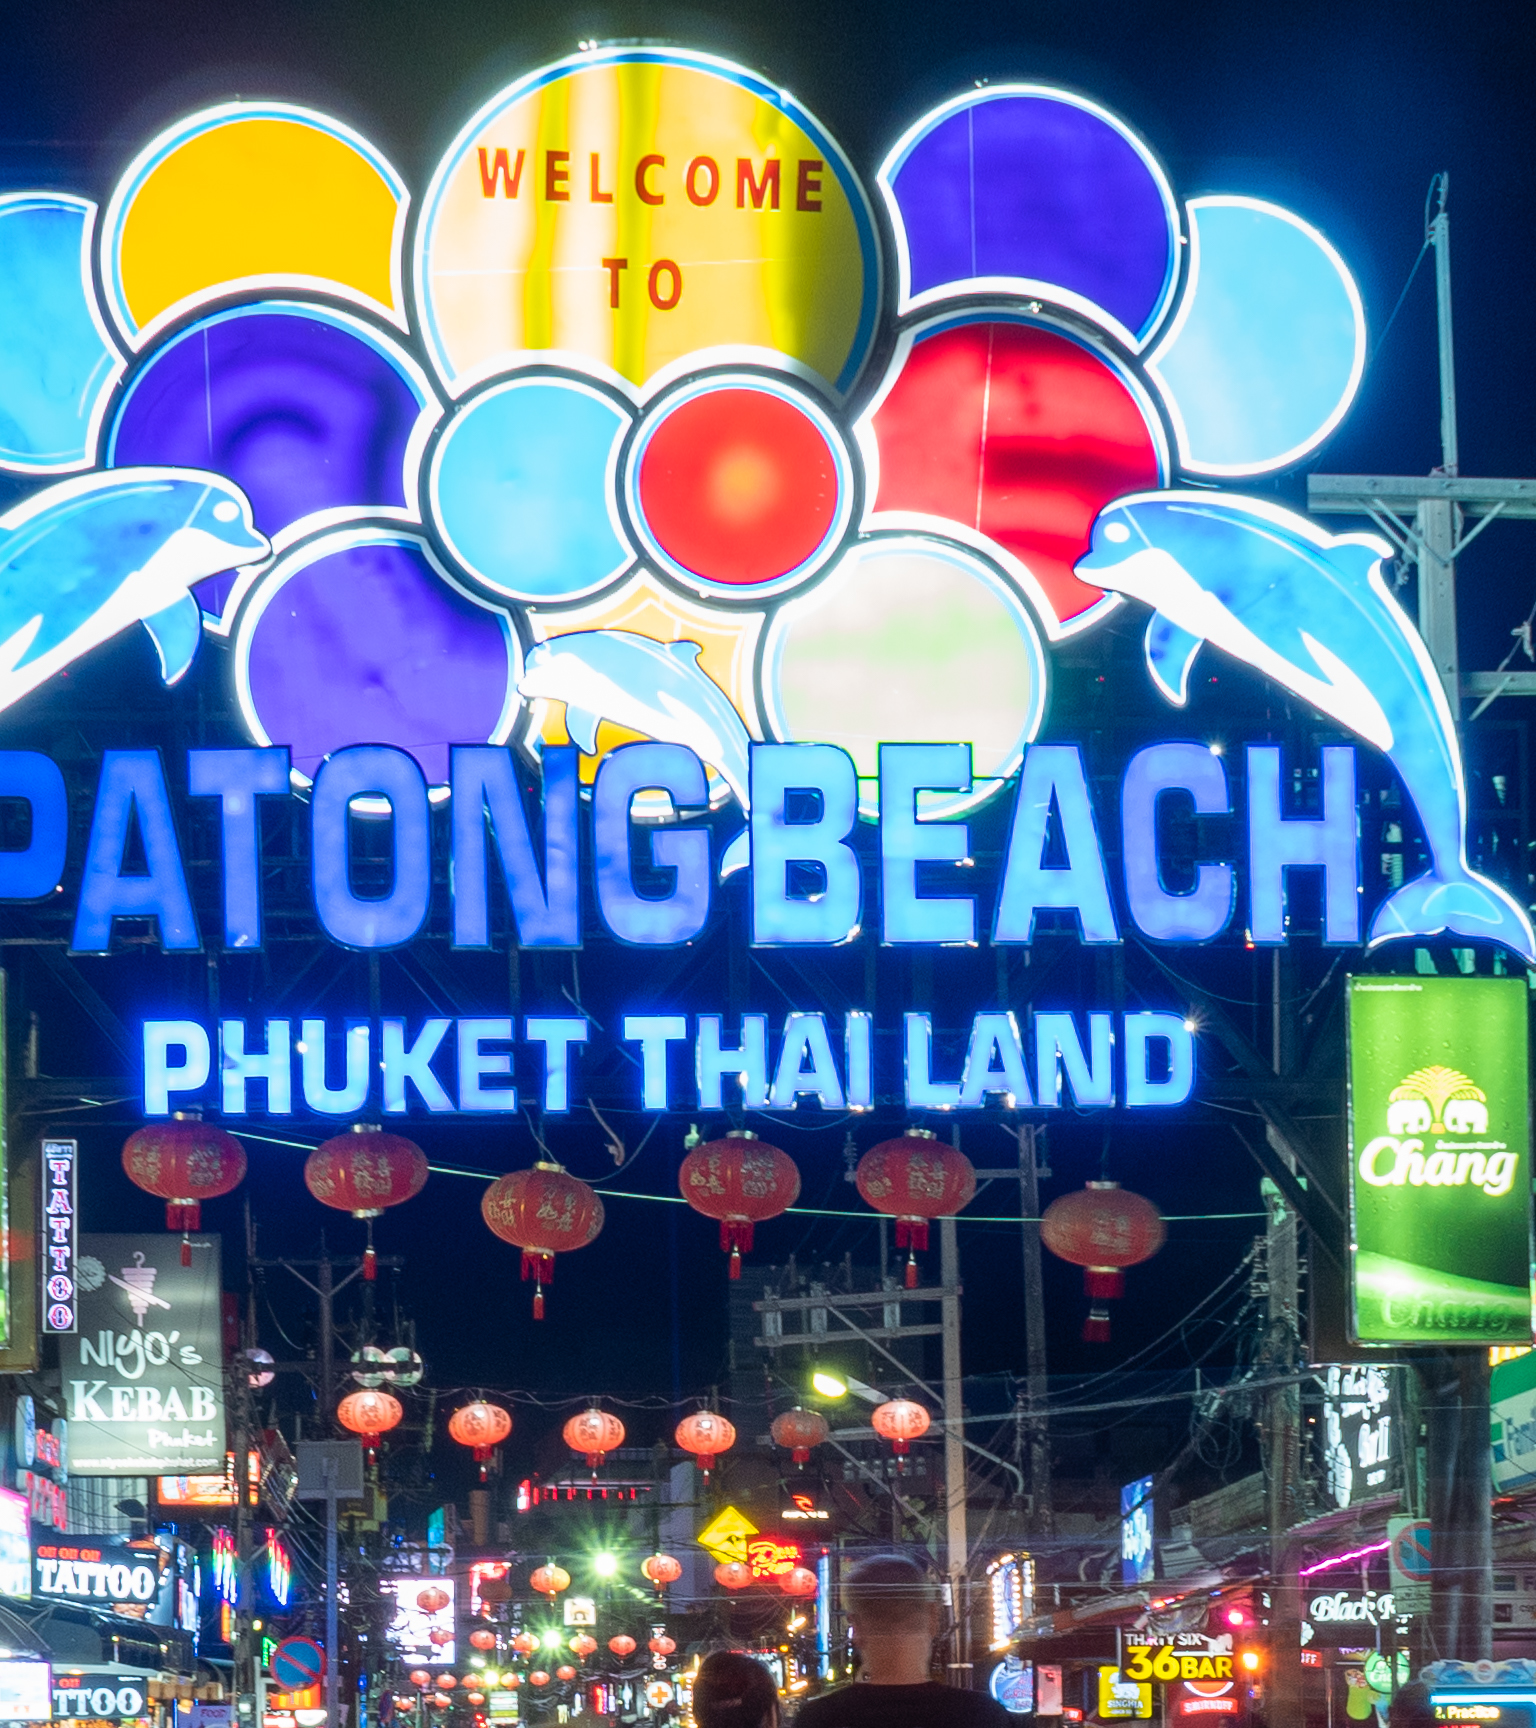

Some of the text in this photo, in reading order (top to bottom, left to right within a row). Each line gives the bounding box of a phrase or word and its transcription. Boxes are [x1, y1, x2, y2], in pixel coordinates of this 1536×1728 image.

[477, 147, 823, 212] WELCOME
[602, 258, 682, 310] TO
[747, 740, 1363, 950] BEACH
[140, 1016, 590, 1116] PHUKET
[1359, 1136, 1519, 1197] Chang
[46, 1158, 74, 1330] TATTOO
[69, 1380, 218, 1422] KEBAB
[36, 1558, 156, 1600] TATTOO
[1310, 1591, 1378, 1626] Black
[1177, 1633, 1203, 1646] SIX
